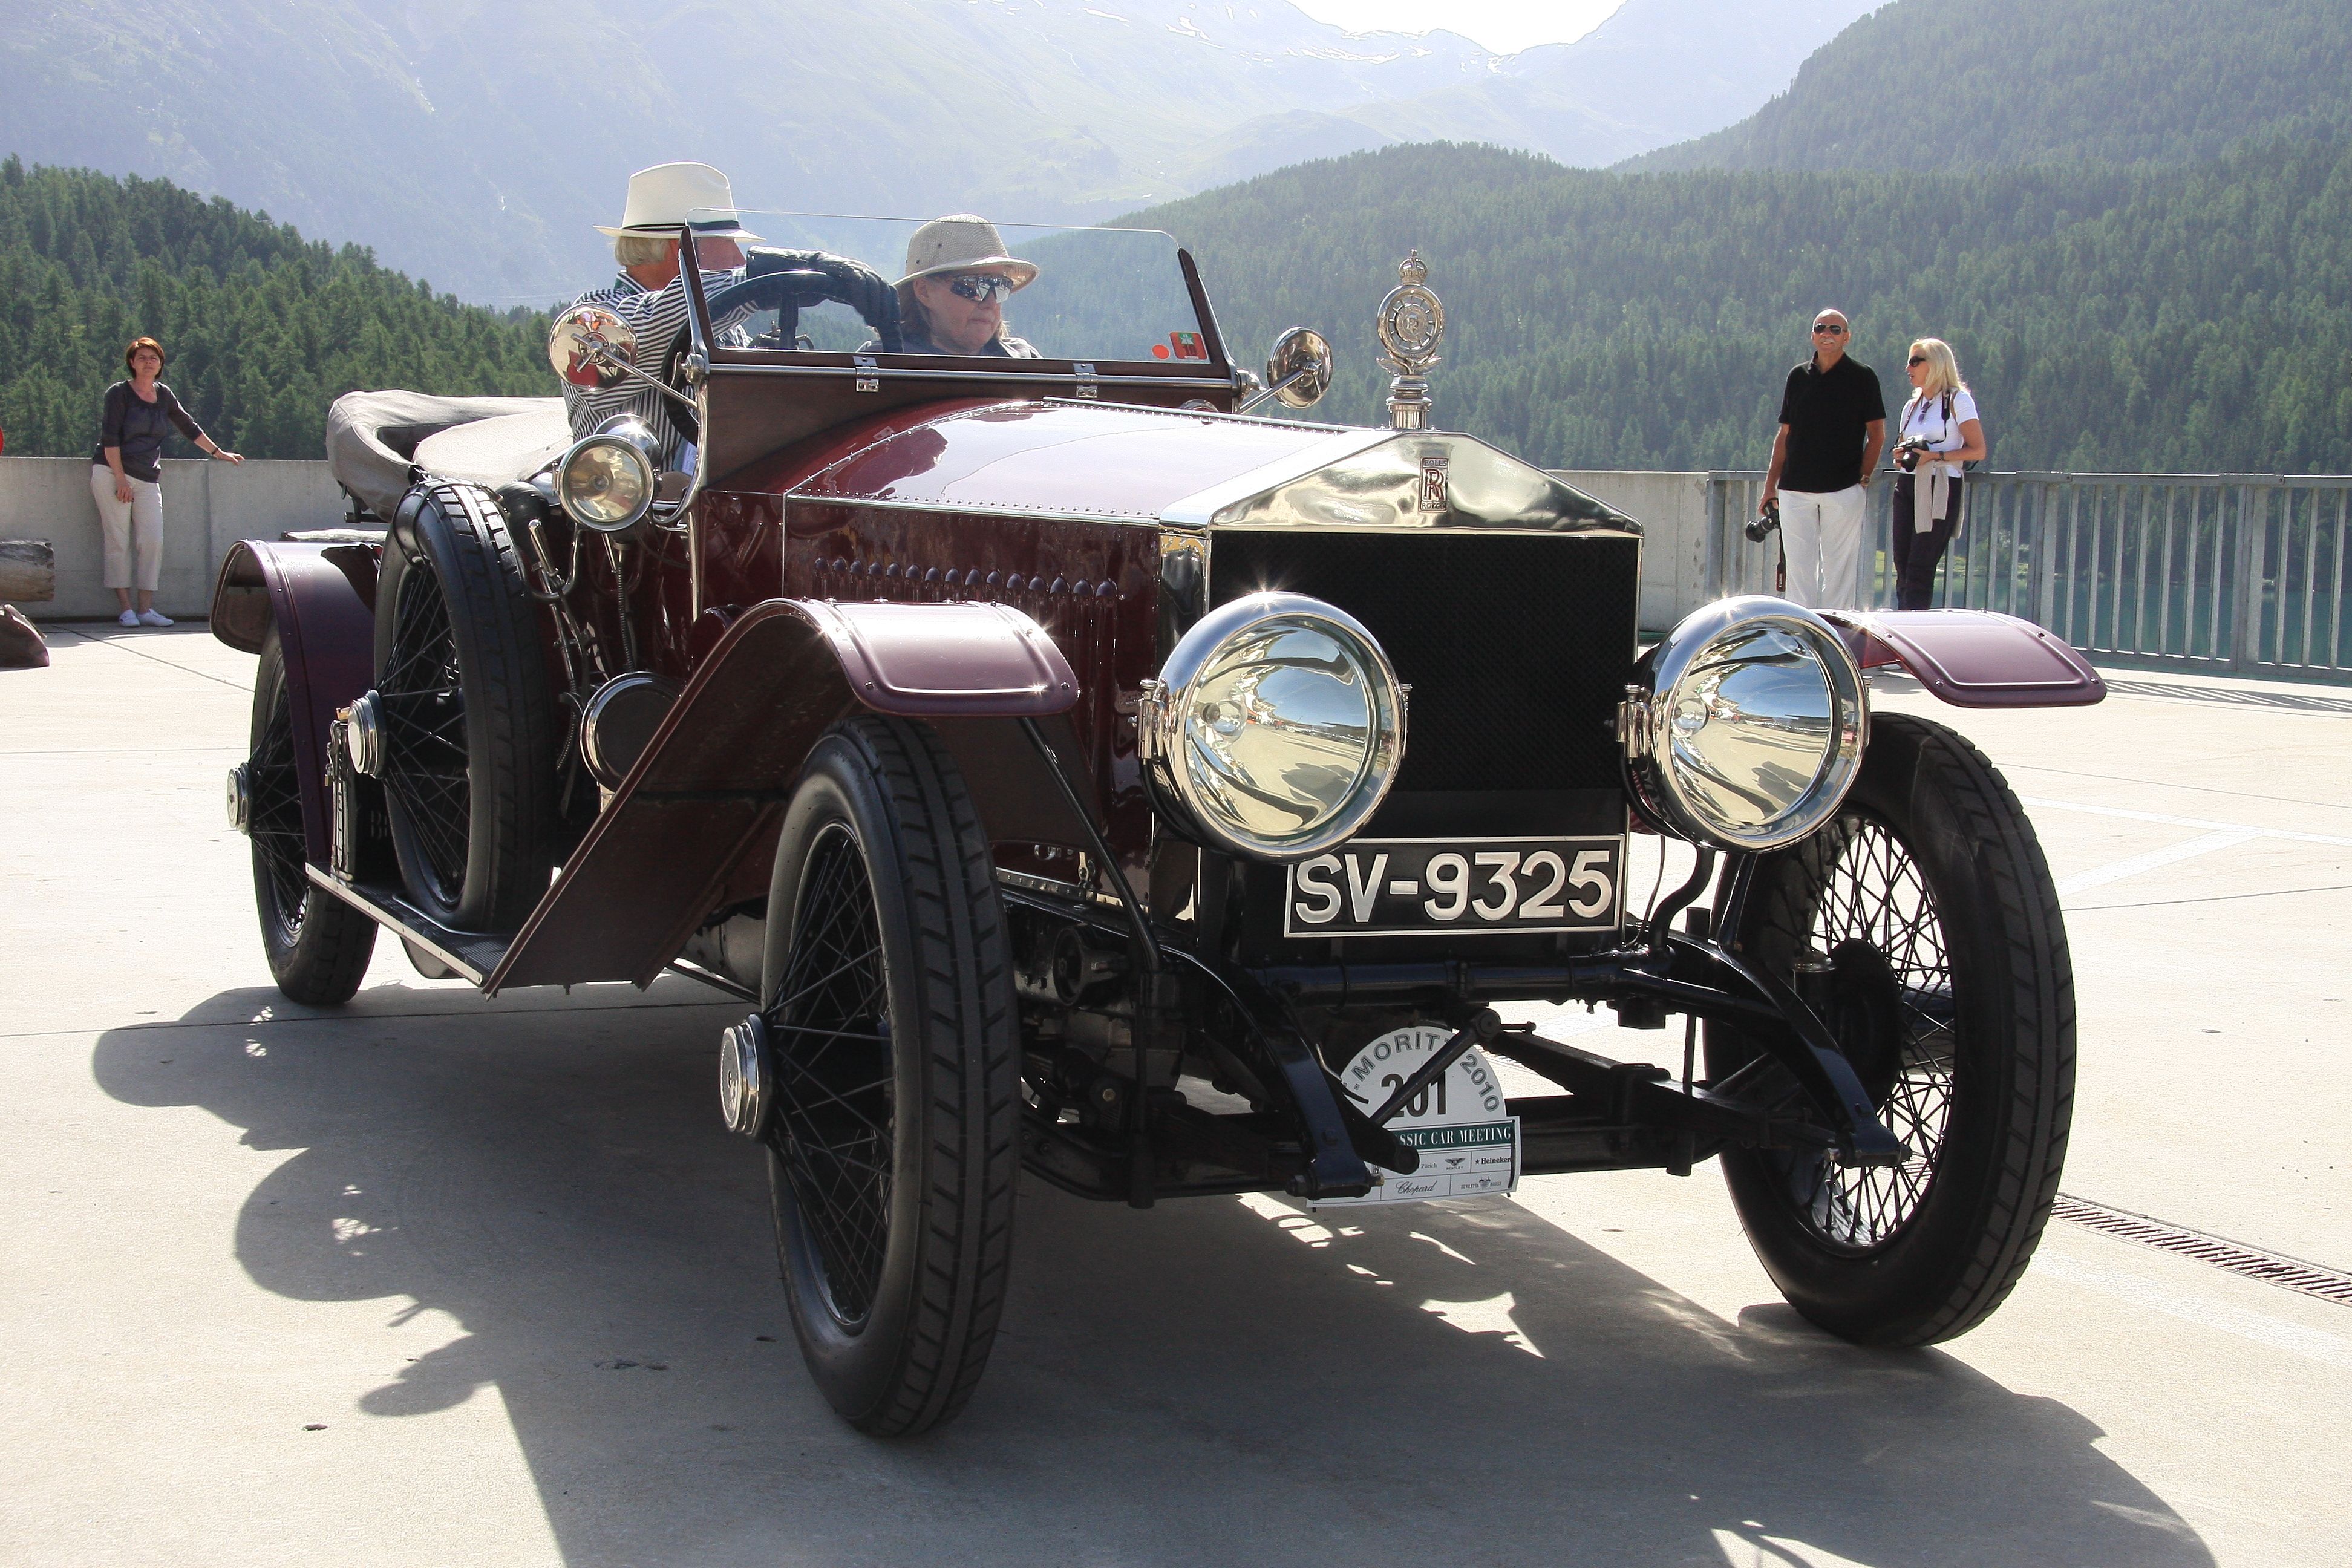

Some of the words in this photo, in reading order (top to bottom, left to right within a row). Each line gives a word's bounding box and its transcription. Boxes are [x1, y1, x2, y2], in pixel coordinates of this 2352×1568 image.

[1295, 850, 1612, 924] SV-9325
[1460, 1053, 1500, 1112] 2010
[1399, 1132, 1426, 1146] SSIC
[1430, 1130, 1454, 1145] CAR
[1459, 1126, 1511, 1143] MEETING
[1395, 1180, 1438, 1196] Chopard
